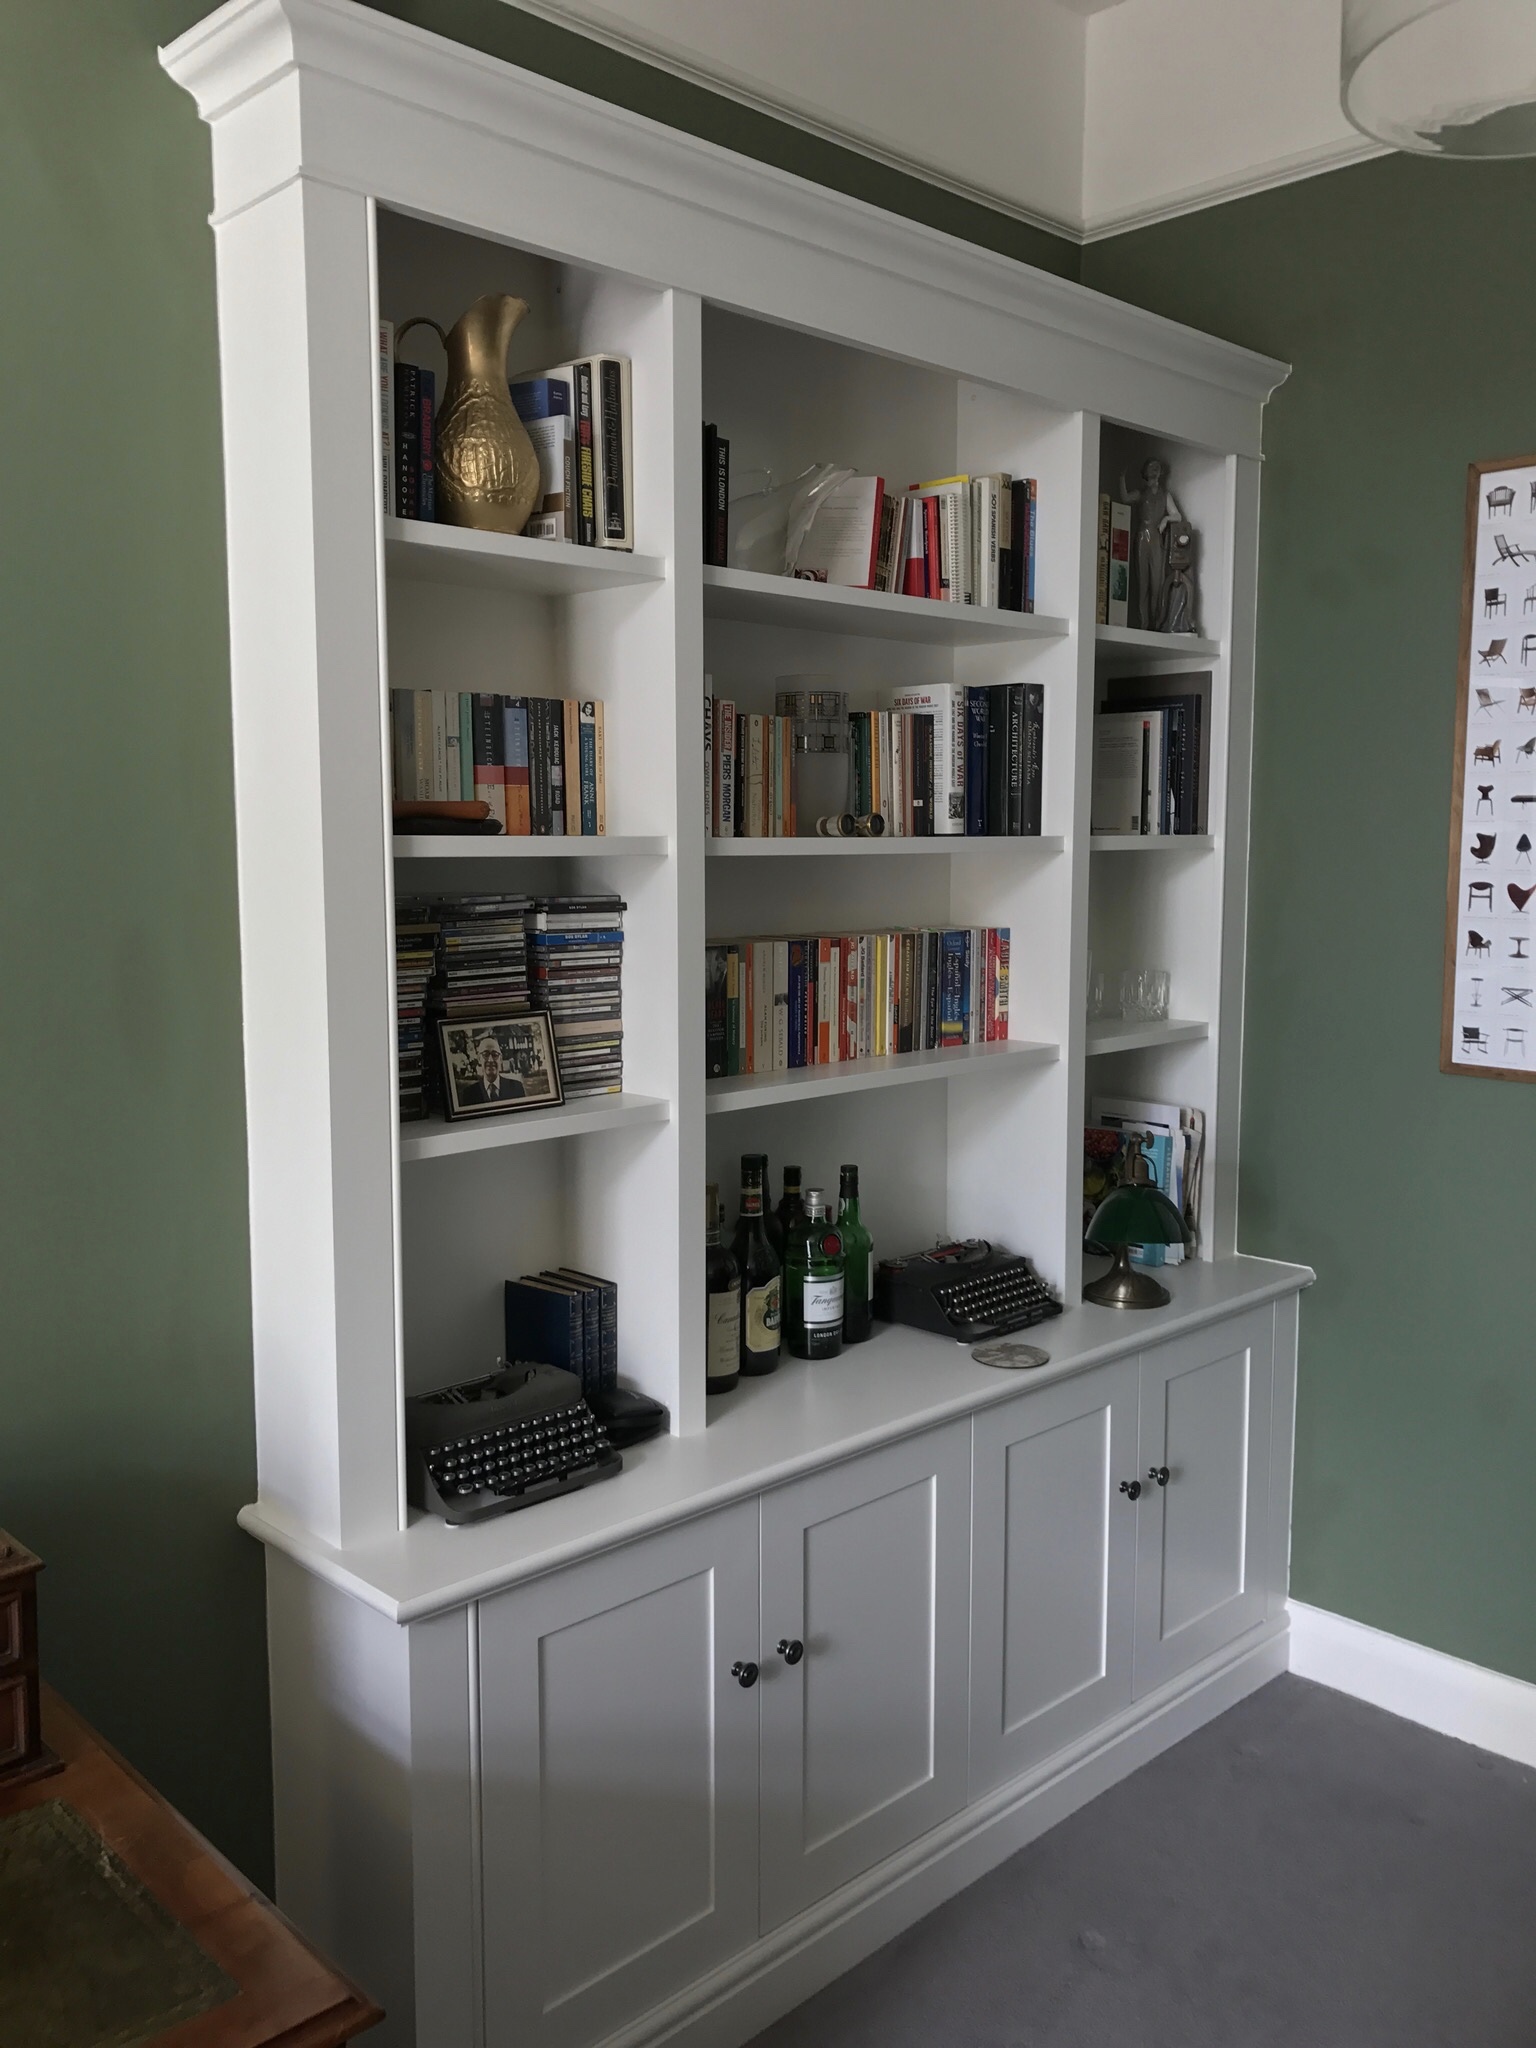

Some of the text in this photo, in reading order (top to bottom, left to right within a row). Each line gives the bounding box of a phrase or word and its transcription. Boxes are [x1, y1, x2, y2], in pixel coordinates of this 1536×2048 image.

[380, 332, 388, 354] WHAT
[380, 357, 388, 374] ARE
[381, 376, 389, 391] YOU
[582, 404, 590, 416] Levy
[422, 398, 431, 456] BRADBURY
[581, 446, 591, 486] FIRESIDE
[718, 468, 725, 476] IS
[583, 488, 593, 518] CHATS
[902, 697, 914, 706] DAYS
[914, 697, 920, 705] OF
[920, 696, 932, 704] WAR
[724, 705, 732, 750] THE INSIDER
[484, 715, 493, 766] STEINBECK
[1010, 711, 1018, 788] ARCHITECTURE
[957, 750, 964, 760] of
[589, 768, 593, 776] OF
[723, 754, 731, 822] PIERS MORGAN
[860, 946, 865, 955] JG
[1000, 974, 1009, 1006] SMITH
[778, 1008, 784, 1016] W
